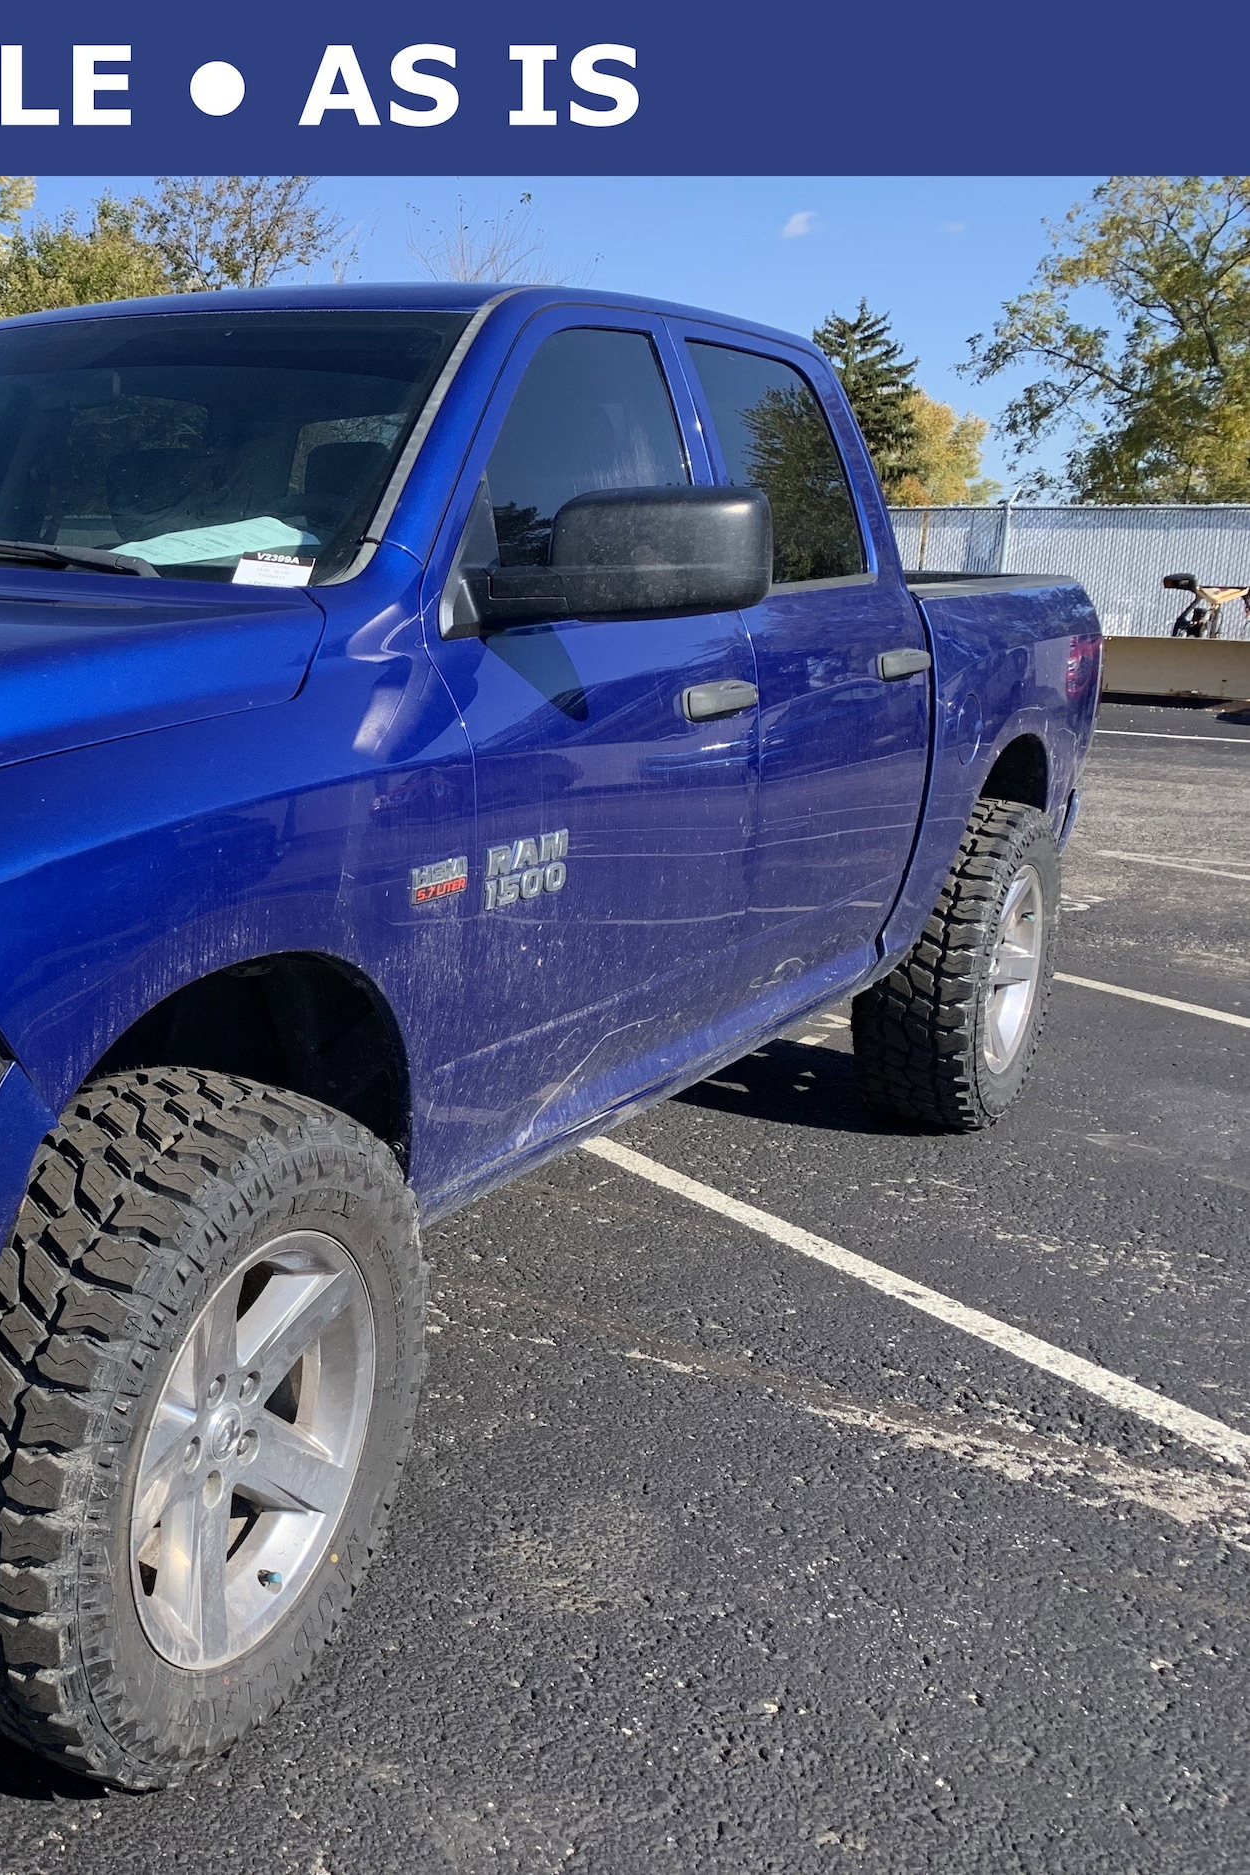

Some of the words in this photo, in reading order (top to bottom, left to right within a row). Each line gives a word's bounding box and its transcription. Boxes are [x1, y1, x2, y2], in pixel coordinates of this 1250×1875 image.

[257, 551, 301, 565] V2399A
[485, 828, 569, 878] RAM
[411, 856, 469, 888] HEMI
[484, 861, 567, 911] 1500
[415, 885, 435, 902] 5.7
[435, 877, 467, 897] LITER
